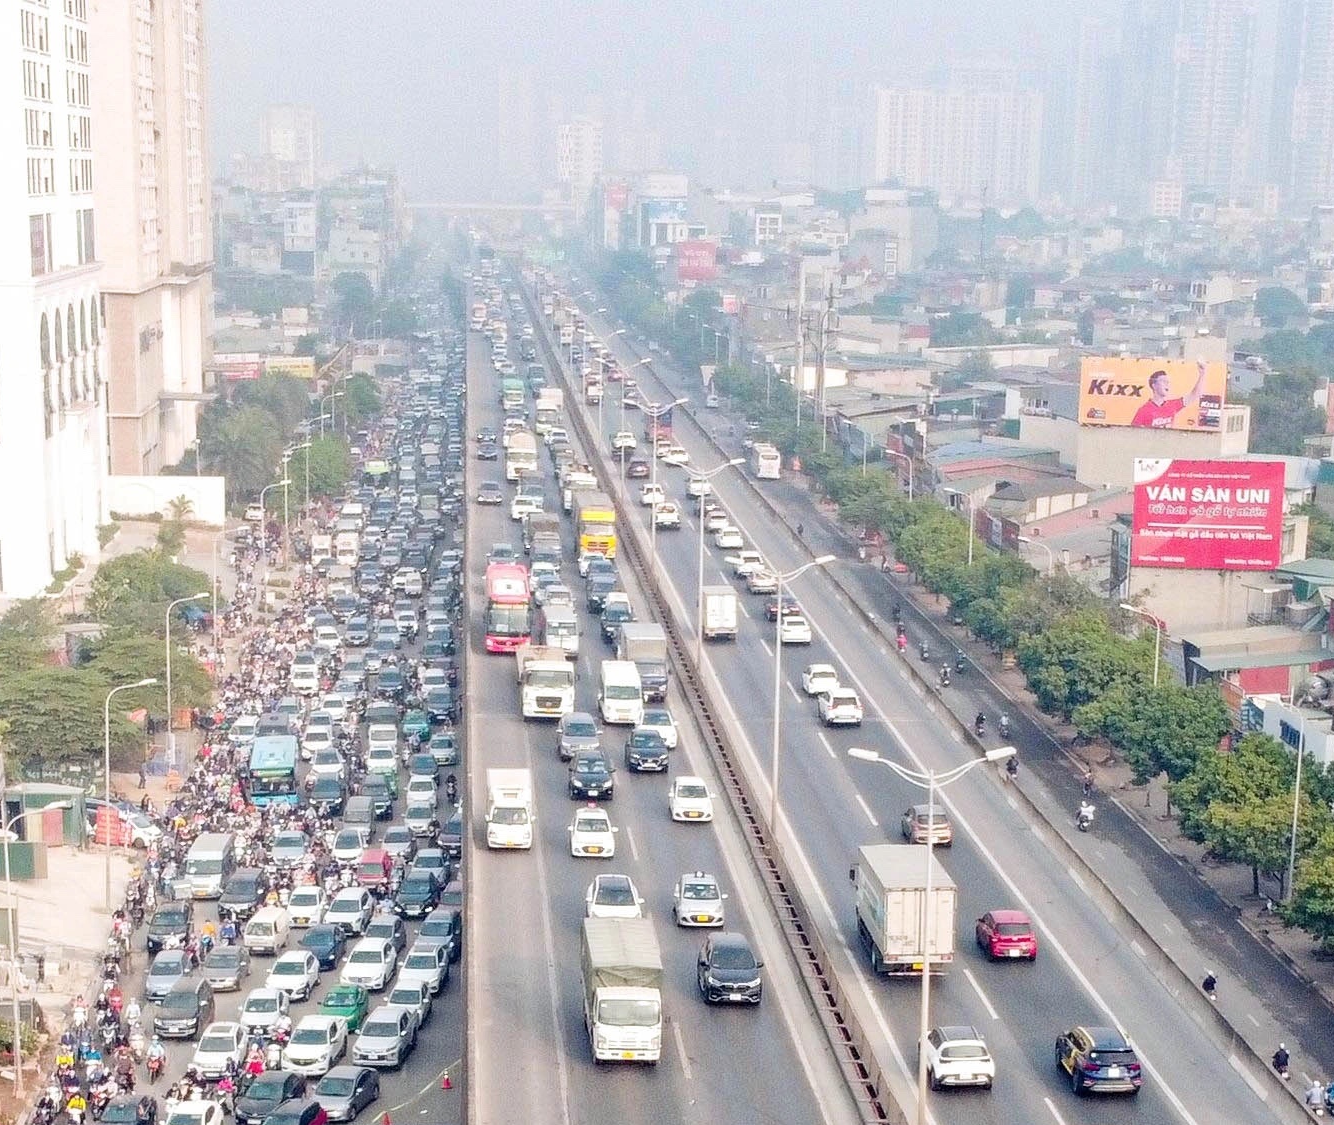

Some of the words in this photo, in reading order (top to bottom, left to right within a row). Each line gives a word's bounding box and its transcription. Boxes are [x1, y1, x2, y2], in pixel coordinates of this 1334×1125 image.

[1088, 379, 1144, 397] Kixx
[1146, 484, 1186, 501] VÁN
[1191, 485, 1230, 502] SÀN
[1236, 488, 1270, 503] UNI
